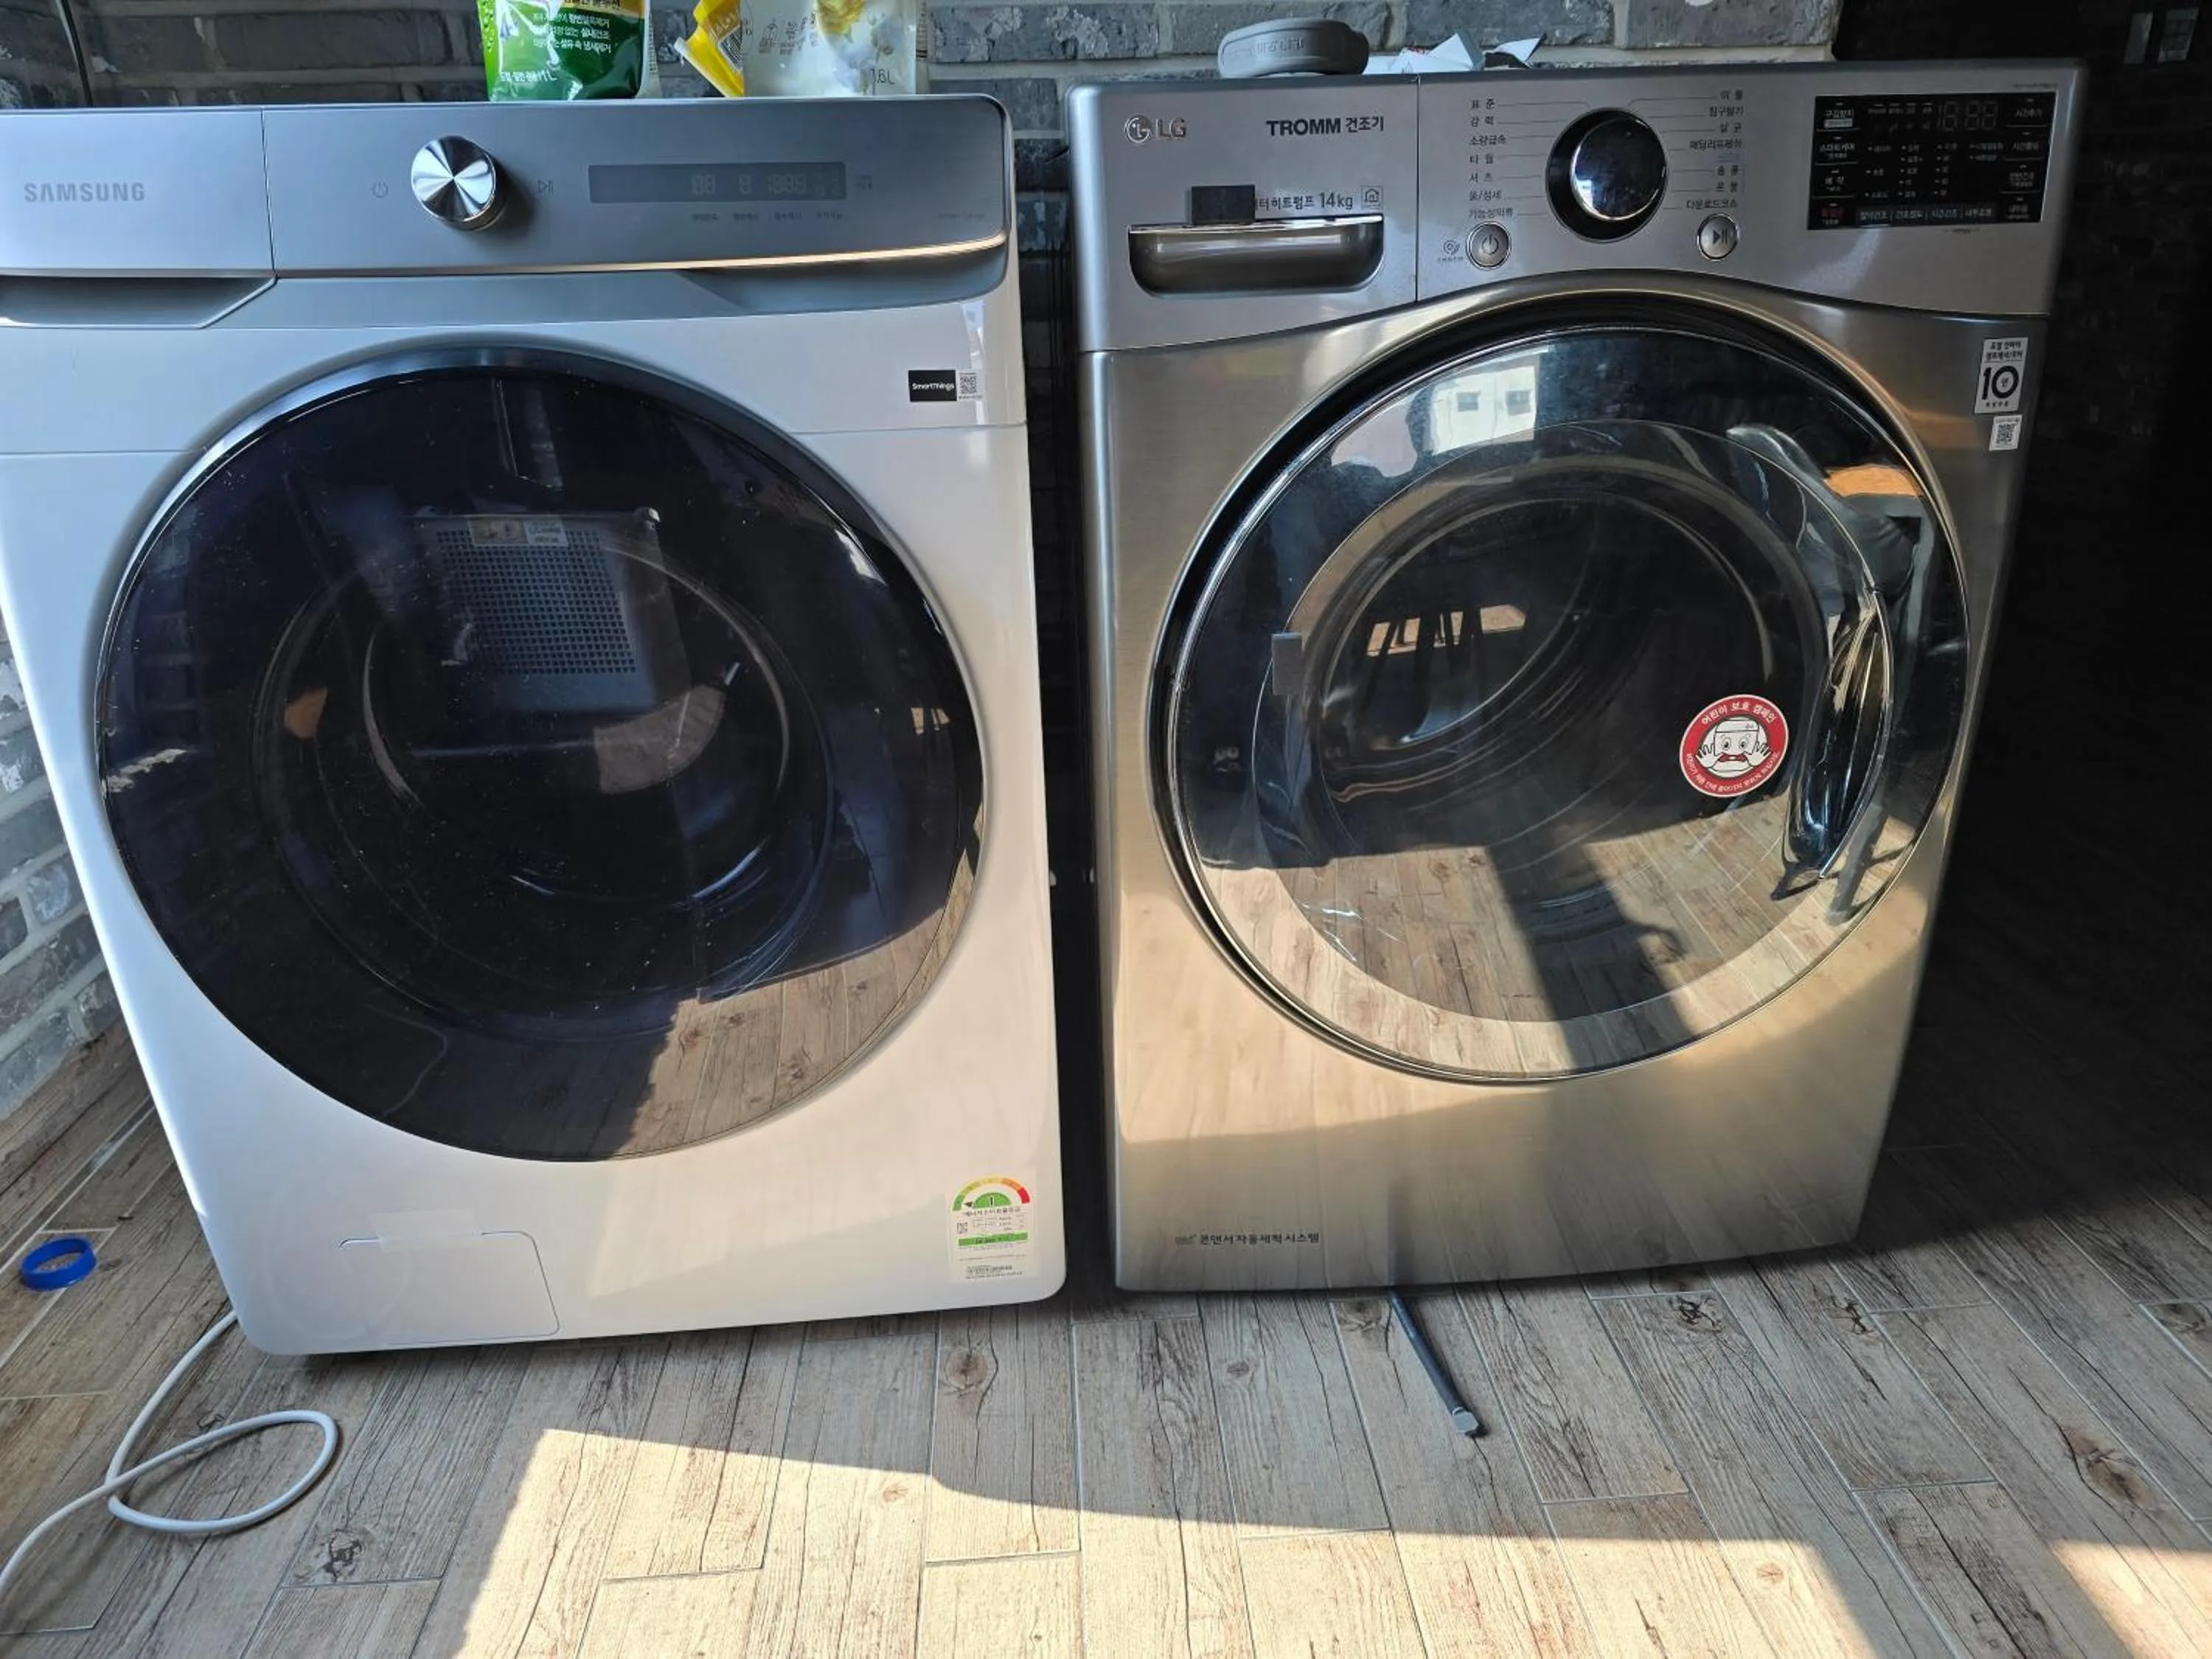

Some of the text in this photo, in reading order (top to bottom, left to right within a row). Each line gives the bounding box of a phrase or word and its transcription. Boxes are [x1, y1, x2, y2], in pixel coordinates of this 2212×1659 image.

[1155, 117, 1186, 139] LG
[1266, 116, 1384, 136] TROMM 건조기
[24, 182, 145, 203] SAMSUNG
[1319, 191, 1354, 210] 14kg
[912, 382, 955, 392] SmartThings
[1981, 365, 2020, 400] 10
[1702, 705, 1728, 725] 어린이
[1731, 701, 1750, 711] 보호
